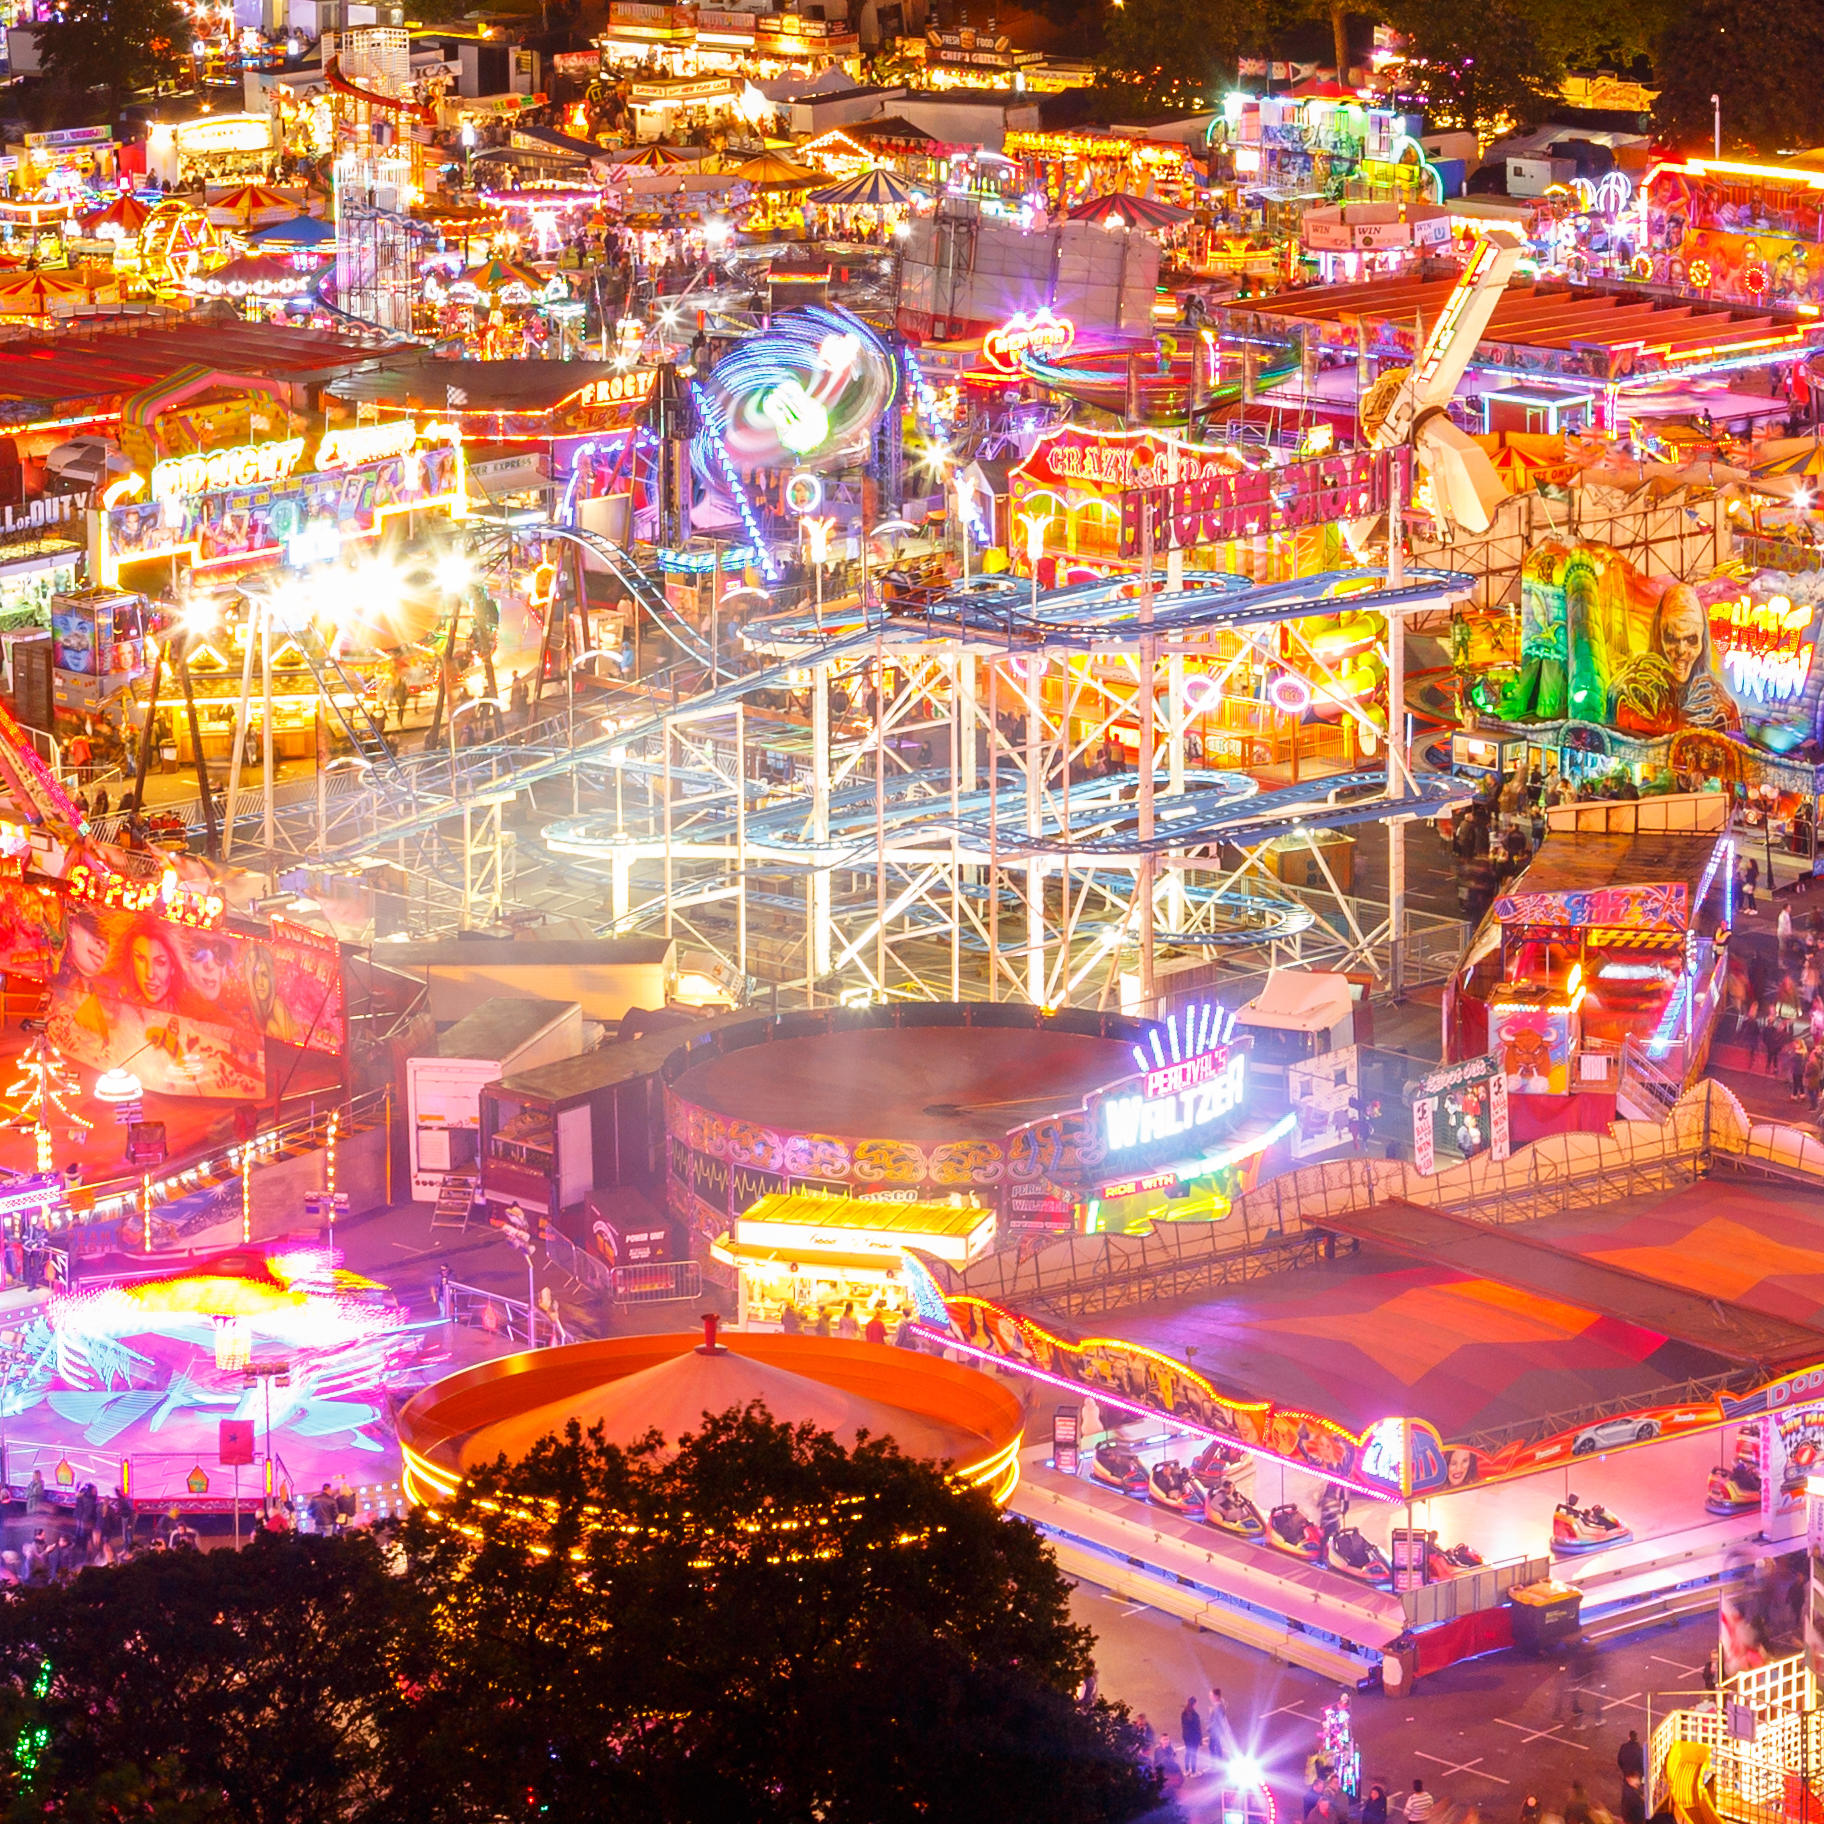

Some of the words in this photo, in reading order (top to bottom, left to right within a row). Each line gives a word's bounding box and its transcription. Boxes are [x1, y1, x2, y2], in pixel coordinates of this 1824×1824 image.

[942, 35, 960, 45] FRESH
[976, 38, 994, 49] FOOD
[940, 50, 970, 62] CHEF'S
[1312, 225, 1329, 234] WIN
[1358, 226, 1381, 235] WIN
[1417, 223, 1431, 232] WIN
[494, 458, 531, 470] EXPRESS
[1047, 445, 1134, 485] CRAZY
[16, 517, 31, 530] OF
[31, 492, 88, 526] DUTY
[1147, 1048, 1227, 1098] PERCIVAL'S
[1105, 1054, 1245, 1150] WALTZER
[1105, 1182, 1137, 1198] RIDE
[1142, 1173, 1174, 1191] WITH
[626, 1232, 648, 1243] POWER
[649, 1231, 665, 1241] UNIT
